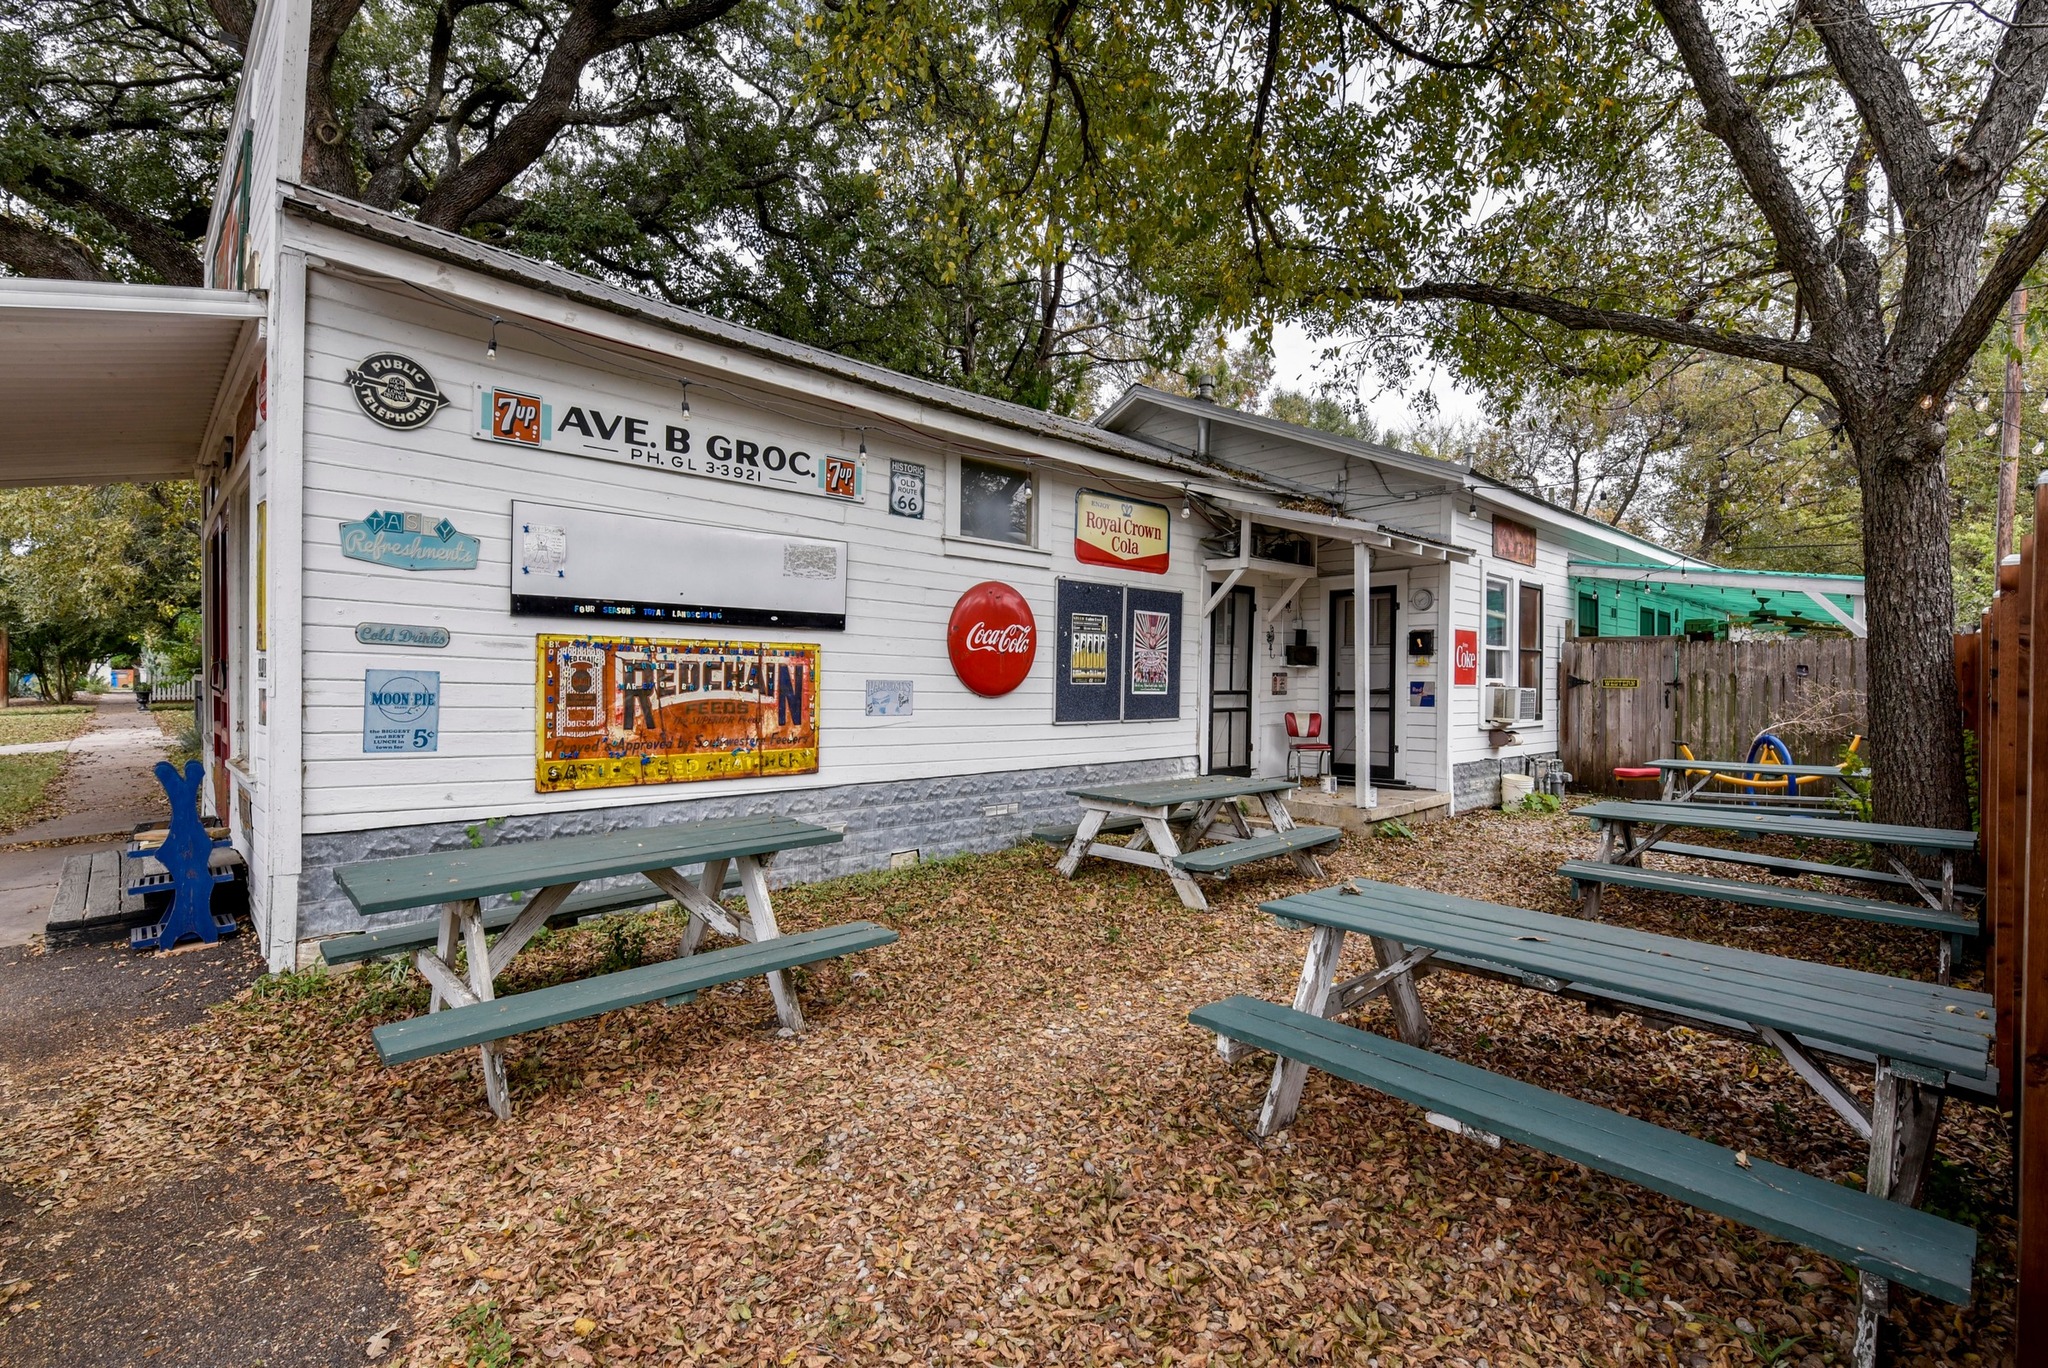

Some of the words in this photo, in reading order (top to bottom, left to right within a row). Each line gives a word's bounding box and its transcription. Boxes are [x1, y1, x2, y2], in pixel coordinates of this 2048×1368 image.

[371, 359, 425, 382] PUBLIC
[361, 388, 431, 422] TELEPHONE
[557, 406, 657, 449] AVE.
[666, 425, 691, 454] B
[707, 435, 816, 479] GROC.
[631, 448, 664, 466] PH.
[672, 456, 697, 471] GL
[706, 462, 761, 482] 3-3921
[892, 461, 924, 476] HISTORIC
[898, 487, 918, 496] ROUTE
[900, 479, 916, 488] OLD
[898, 495, 917, 511] 66
[1091, 500, 1111, 510] ENJOY
[369, 514, 451, 539] TASTY
[1086, 511, 1122, 536] Royal
[1124, 519, 1162, 541] Crown
[345, 529, 474, 563] Refreshments
[1111, 536, 1139, 555] Cola
[574, 604, 596, 614] FOUR
[602, 605, 636, 615] SEASONS
[643, 608, 666, 617] TOTAL
[671, 610, 723, 620] LANDSCAPING
[360, 626, 395, 642] Cold
[399, 629, 445, 646] Drinks
[966, 622, 1033, 654] Coca-Cola
[1456, 645, 1476, 668] Coke
[371, 692, 410, 706] MOON
[414, 692, 436, 706] PIE
[685, 702, 749, 715] FEEDS
[616, 737, 673, 756] Approved
[676, 735, 690, 750] by
